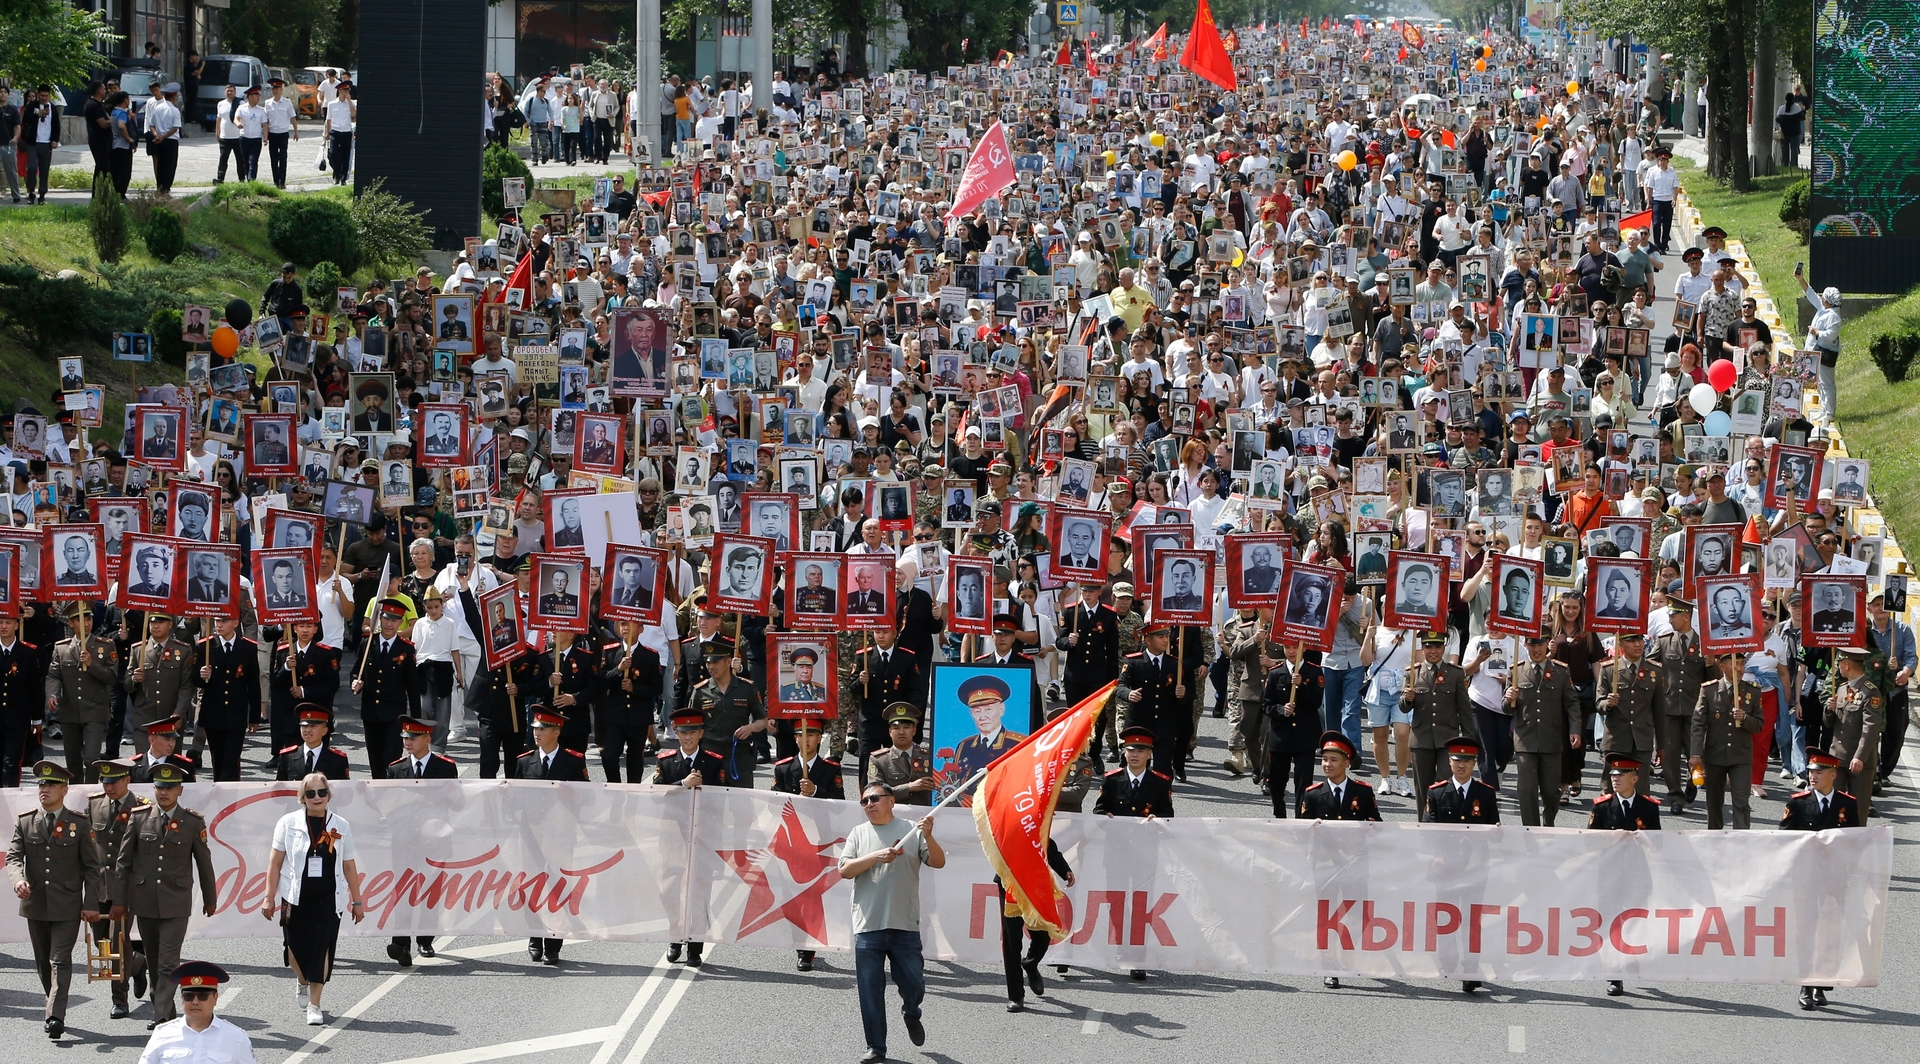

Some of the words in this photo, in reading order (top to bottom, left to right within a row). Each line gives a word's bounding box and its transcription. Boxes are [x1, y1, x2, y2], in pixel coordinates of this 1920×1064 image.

[517, 346, 554, 354] ОРОЗОБЕК
[603, 613, 631, 621] Александр
[1013, 785, 1035, 812] 79
[210, 789, 624, 930] беертный
[1316, 899, 1787, 958] КЫРГЫЗСТАН
